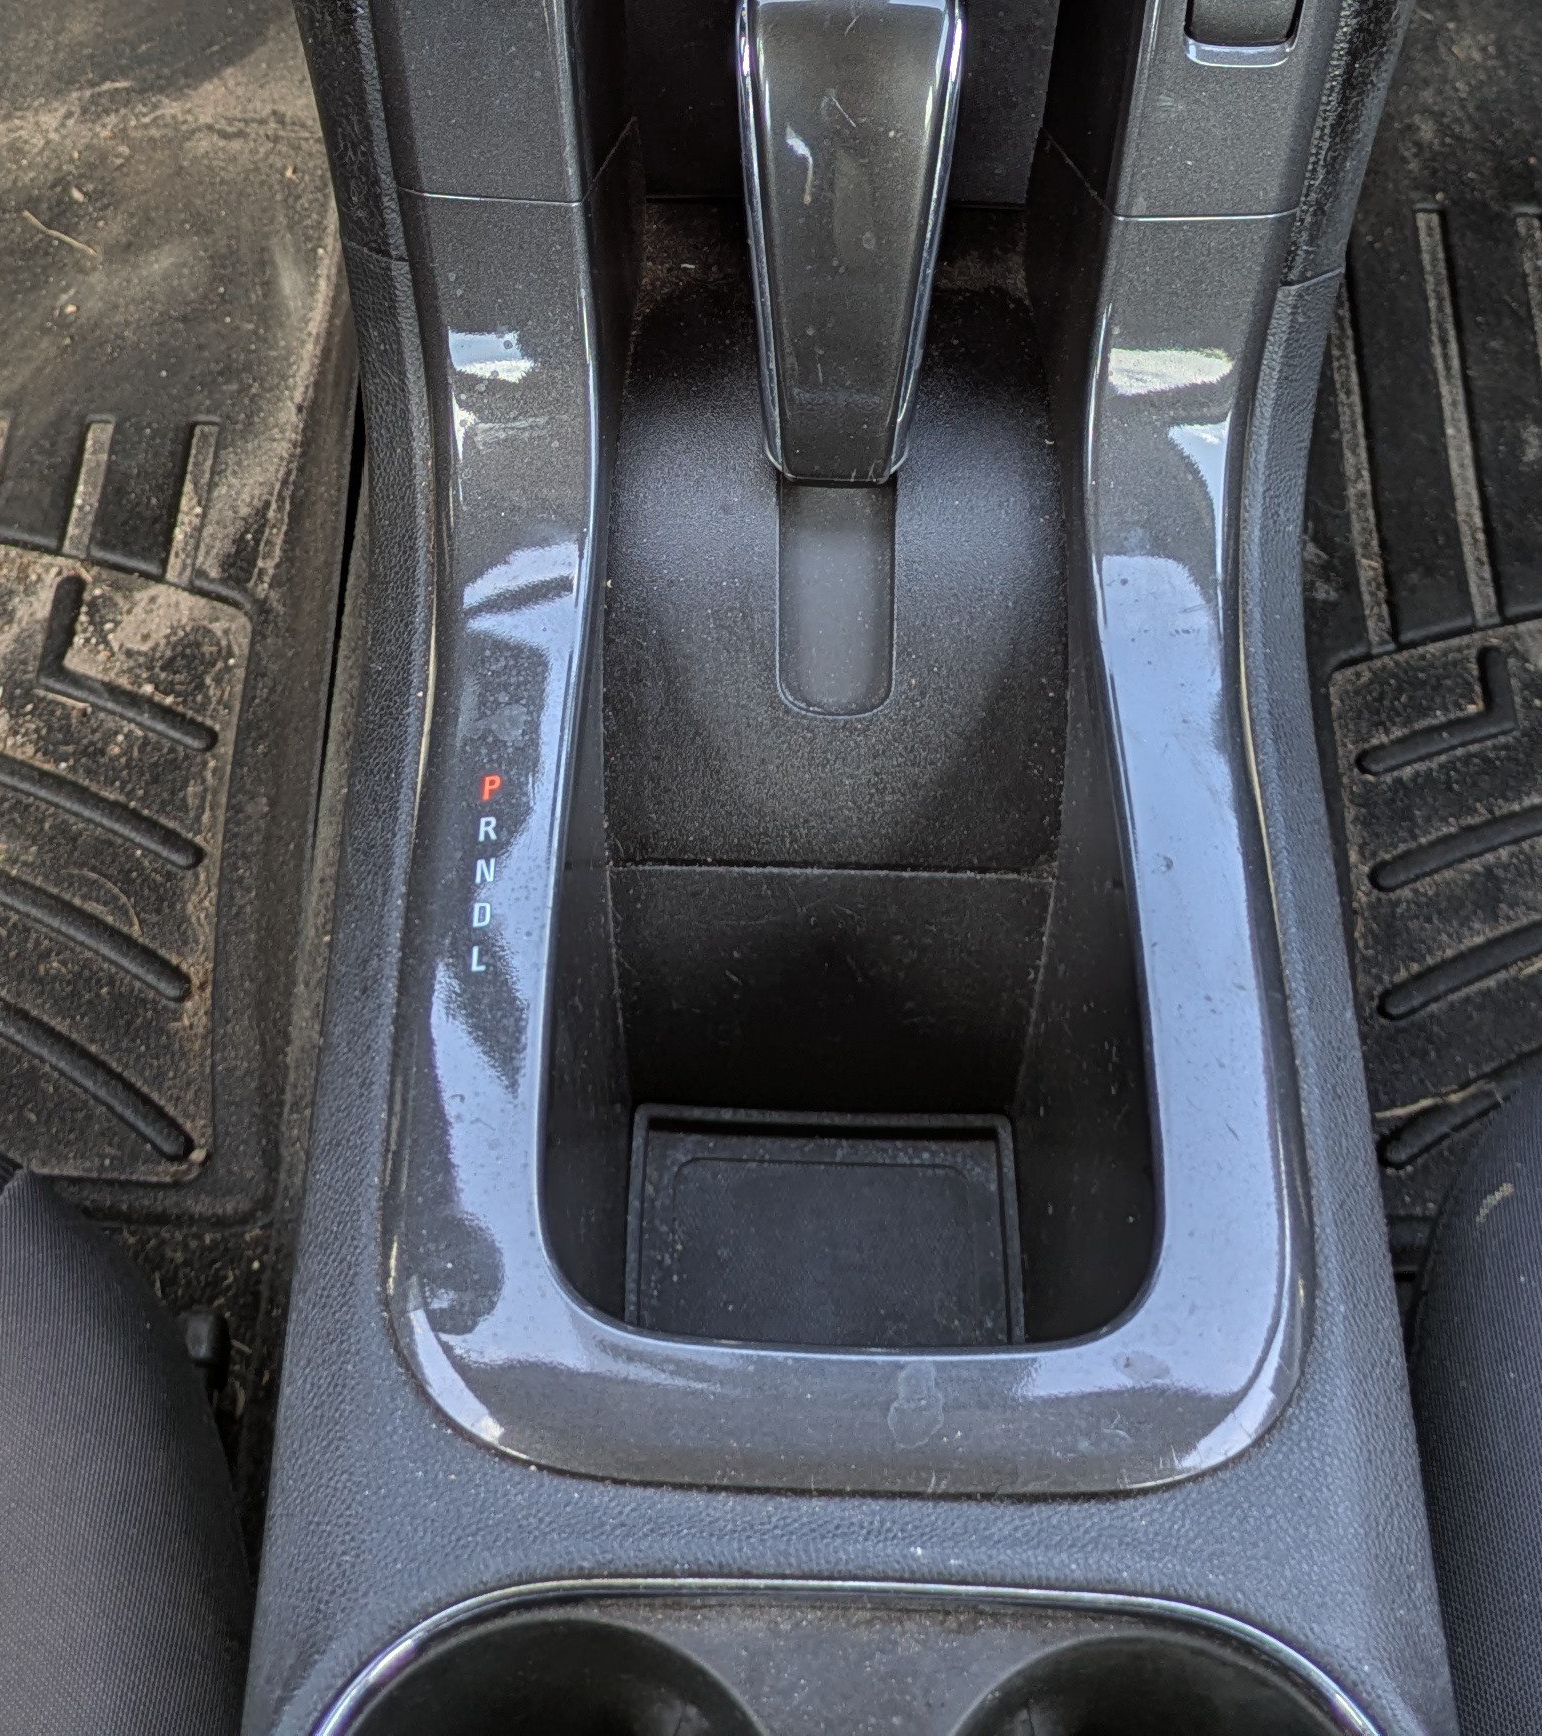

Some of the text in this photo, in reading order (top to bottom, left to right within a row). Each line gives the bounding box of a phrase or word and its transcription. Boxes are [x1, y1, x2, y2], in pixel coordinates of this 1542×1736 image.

[481, 775, 501, 801] P
[478, 816, 497, 842] R
[475, 858, 496, 885] N
[472, 902, 491, 928] D
[471, 945, 487, 972] L
